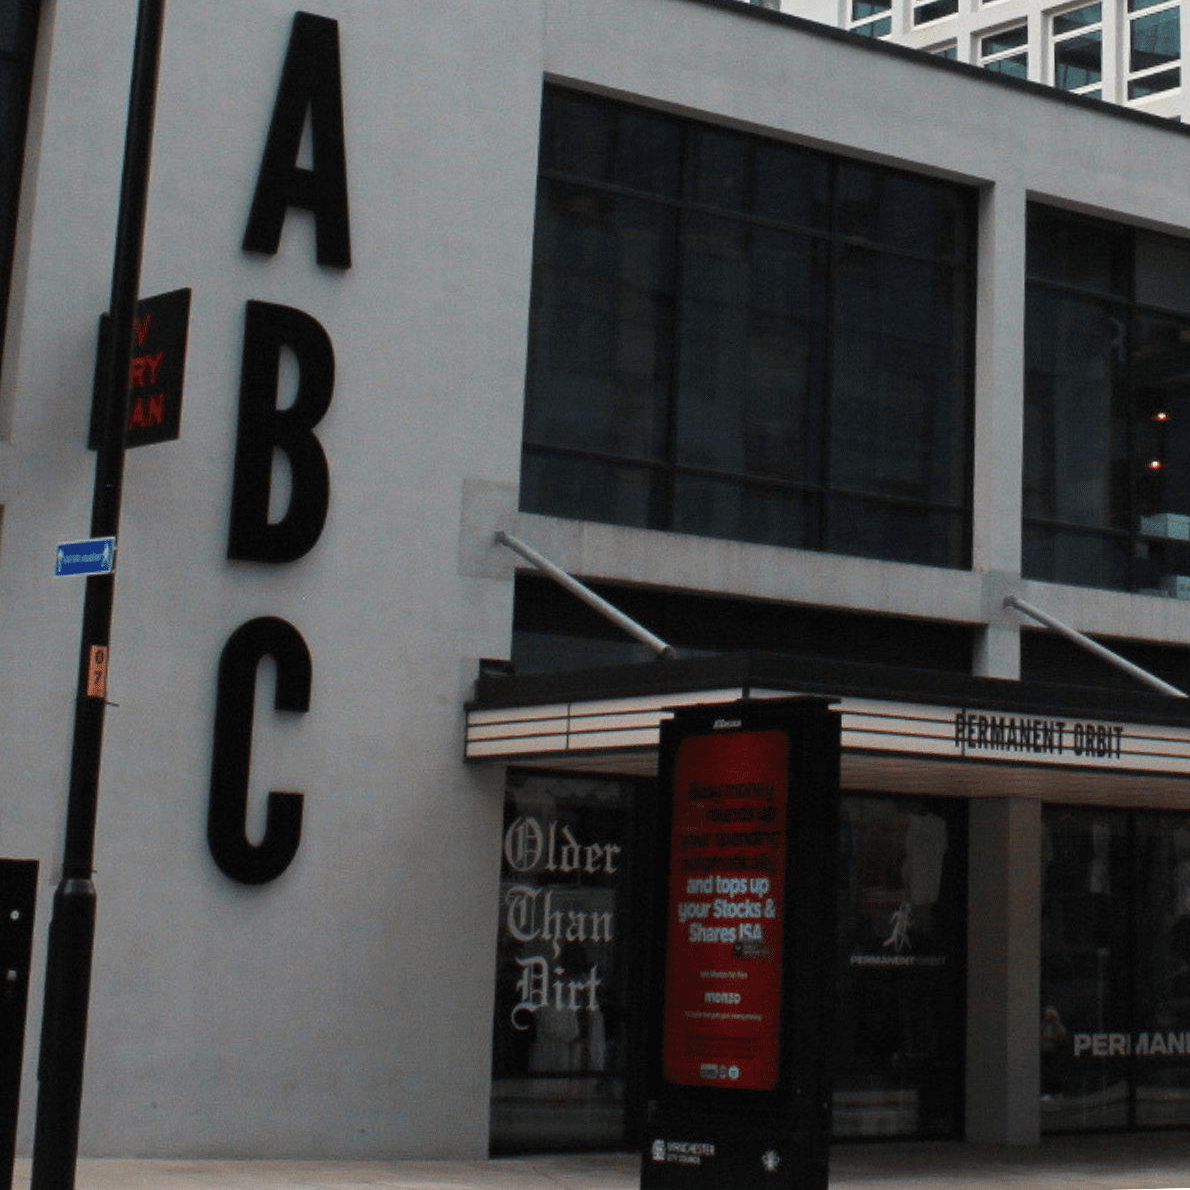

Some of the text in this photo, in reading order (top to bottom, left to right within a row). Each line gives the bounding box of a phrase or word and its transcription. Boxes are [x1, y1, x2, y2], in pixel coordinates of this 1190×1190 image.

[207, 11, 352, 887] ABC
[955, 713, 1123, 760] PERMANENT ORBIT
[504, 816, 621, 874] Older
[686, 875, 770, 898] and tops up
[505, 885, 613, 959] Than
[678, 898, 777, 923] your Stocks &
[688, 922, 763, 943] Shares ISA
[511, 956, 601, 1030] Dirt
[704, 991, 742, 1005] monzo
